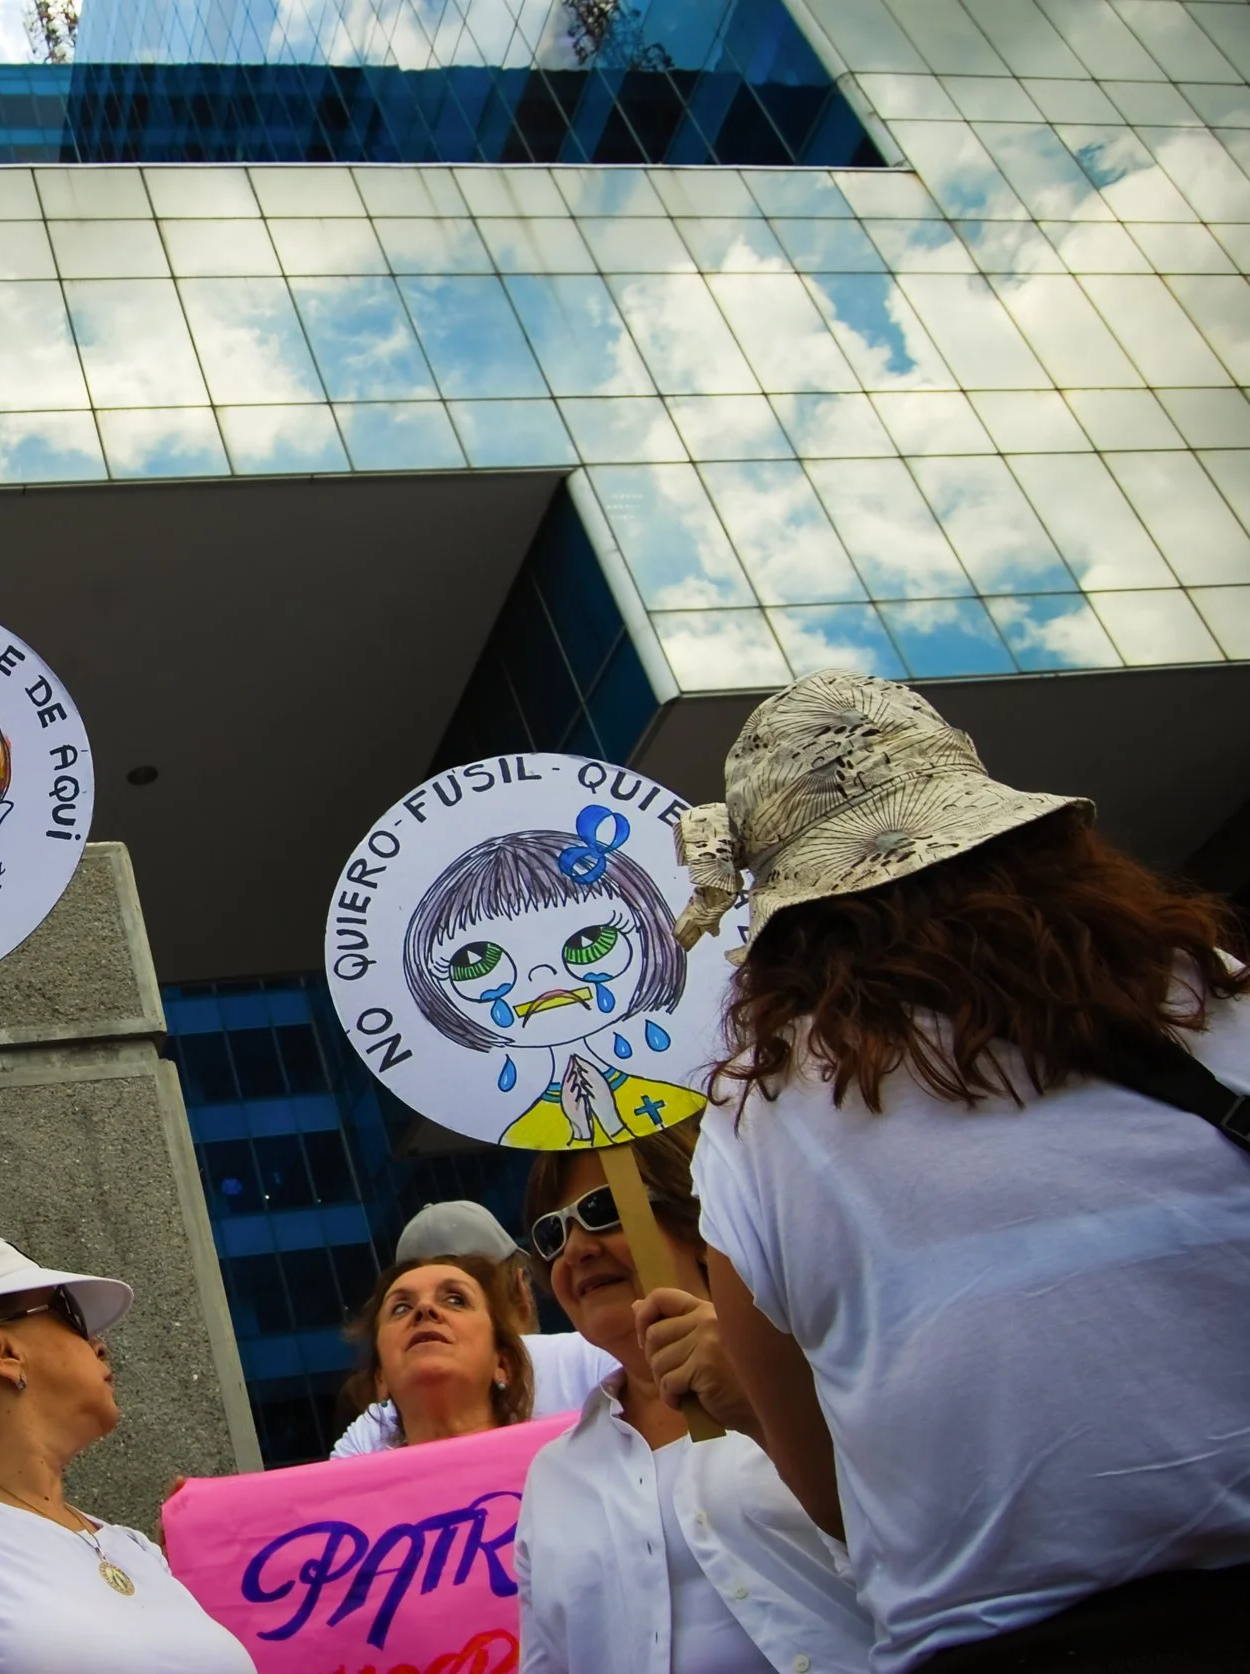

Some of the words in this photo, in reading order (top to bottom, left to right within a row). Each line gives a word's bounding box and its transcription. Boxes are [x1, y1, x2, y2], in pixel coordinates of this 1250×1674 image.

[25, 674, 68, 729] DE
[357, 1006, 413, 1074] NO
[578, 761, 693, 828] QUIE
[241, 1491, 522, 1650] PATR
